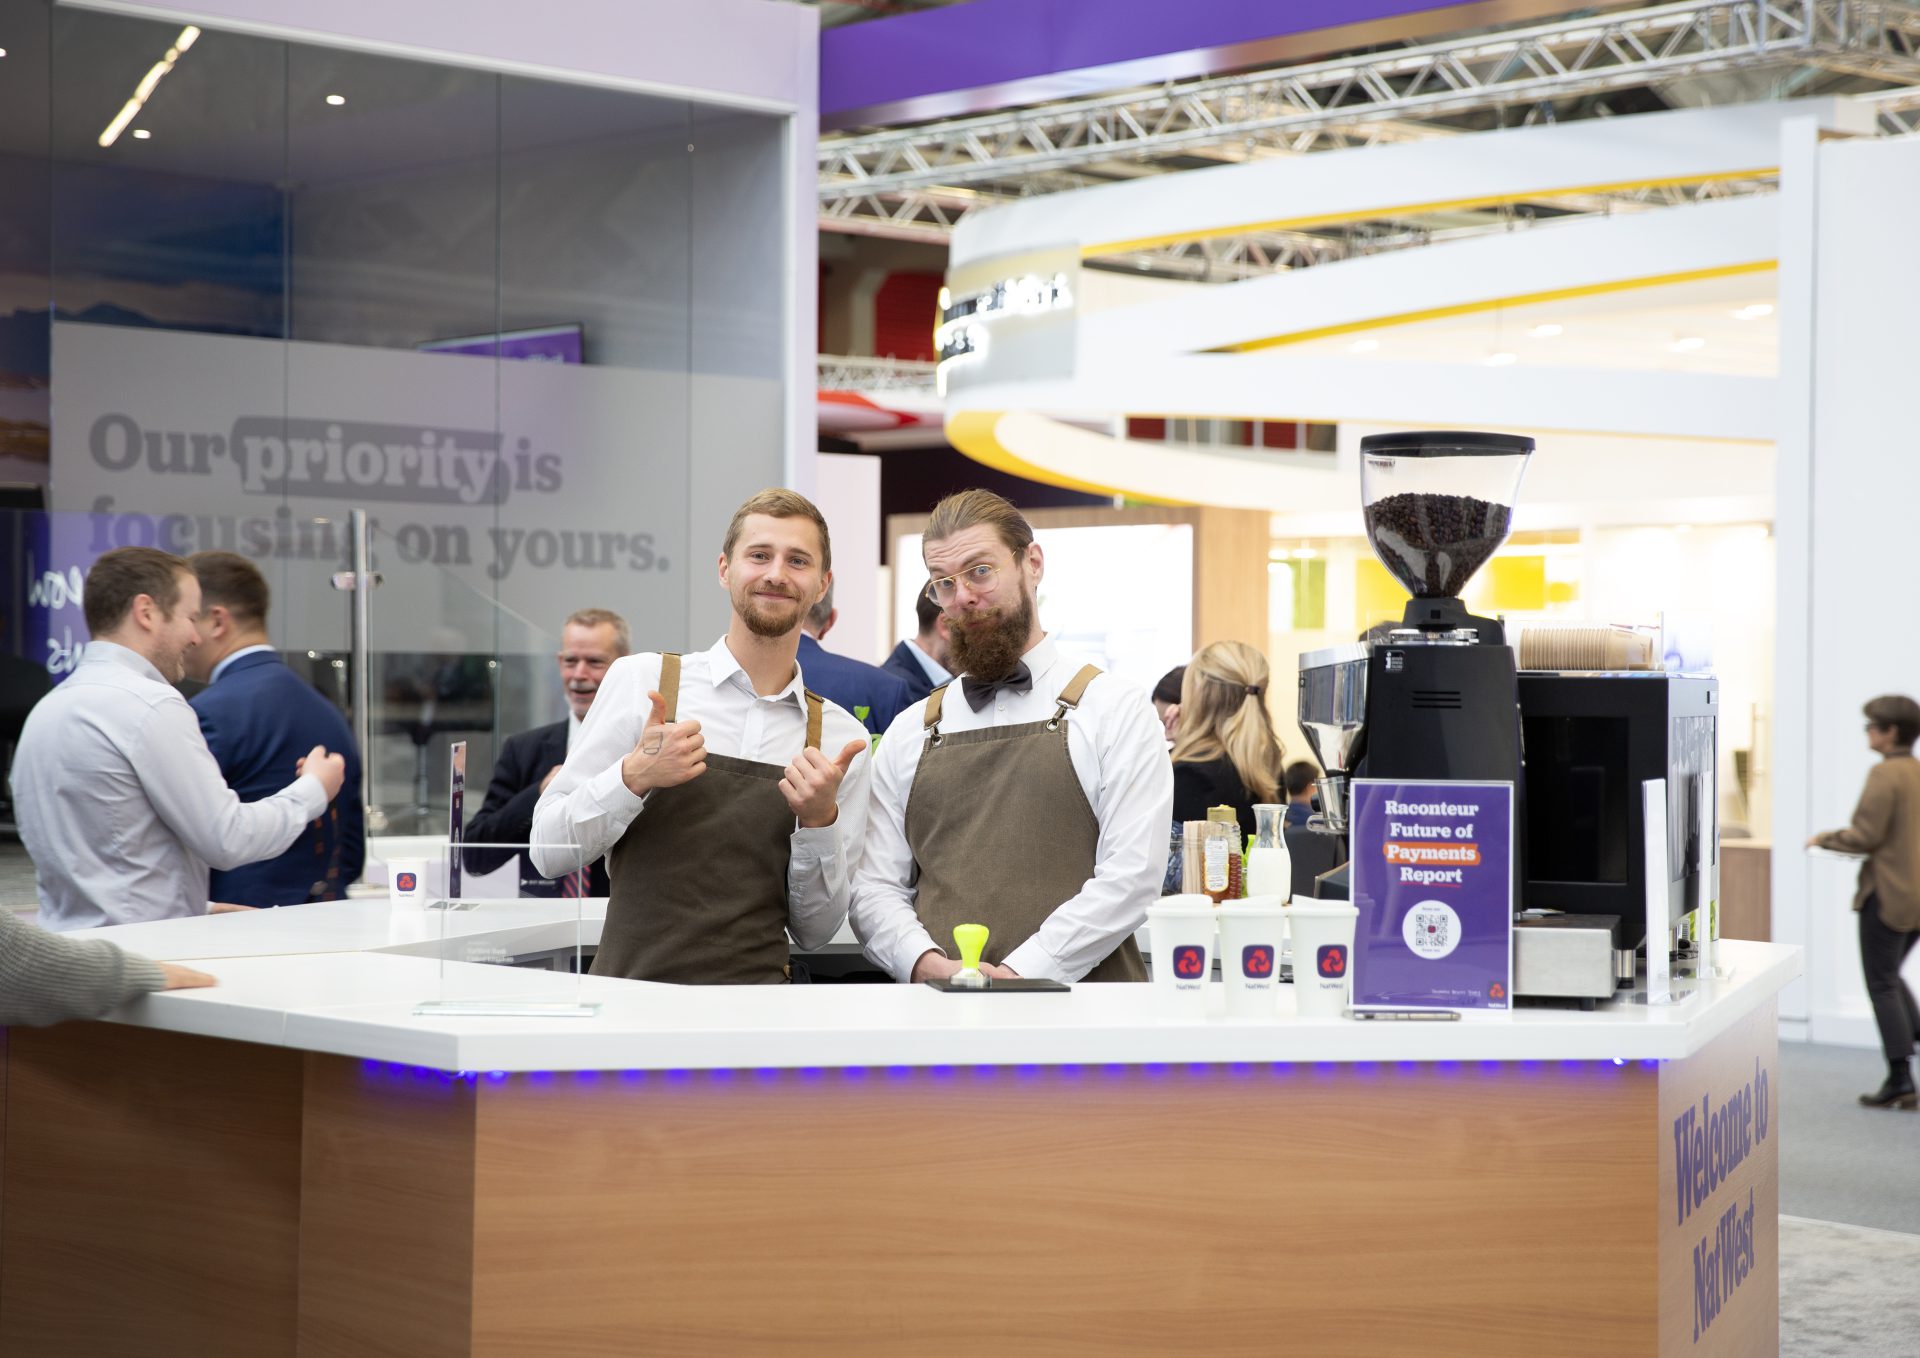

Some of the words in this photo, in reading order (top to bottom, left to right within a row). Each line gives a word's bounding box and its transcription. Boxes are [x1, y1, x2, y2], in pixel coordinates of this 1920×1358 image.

[89, 412, 227, 475] Our
[243, 424, 502, 504] priority
[514, 437, 562, 492] is
[396, 523, 472, 565] on
[486, 525, 671, 580] yours.
[1385, 799, 1479, 817] Raconteur
[1390, 822, 1452, 838] Future
[1455, 823, 1474, 838] of
[1386, 844, 1477, 863] Payments
[1400, 866, 1463, 885] Report
[1674, 1083, 1752, 1227] Welcome
[1754, 1056, 1769, 1146] to
[1693, 1186, 1755, 1344] NatWest
